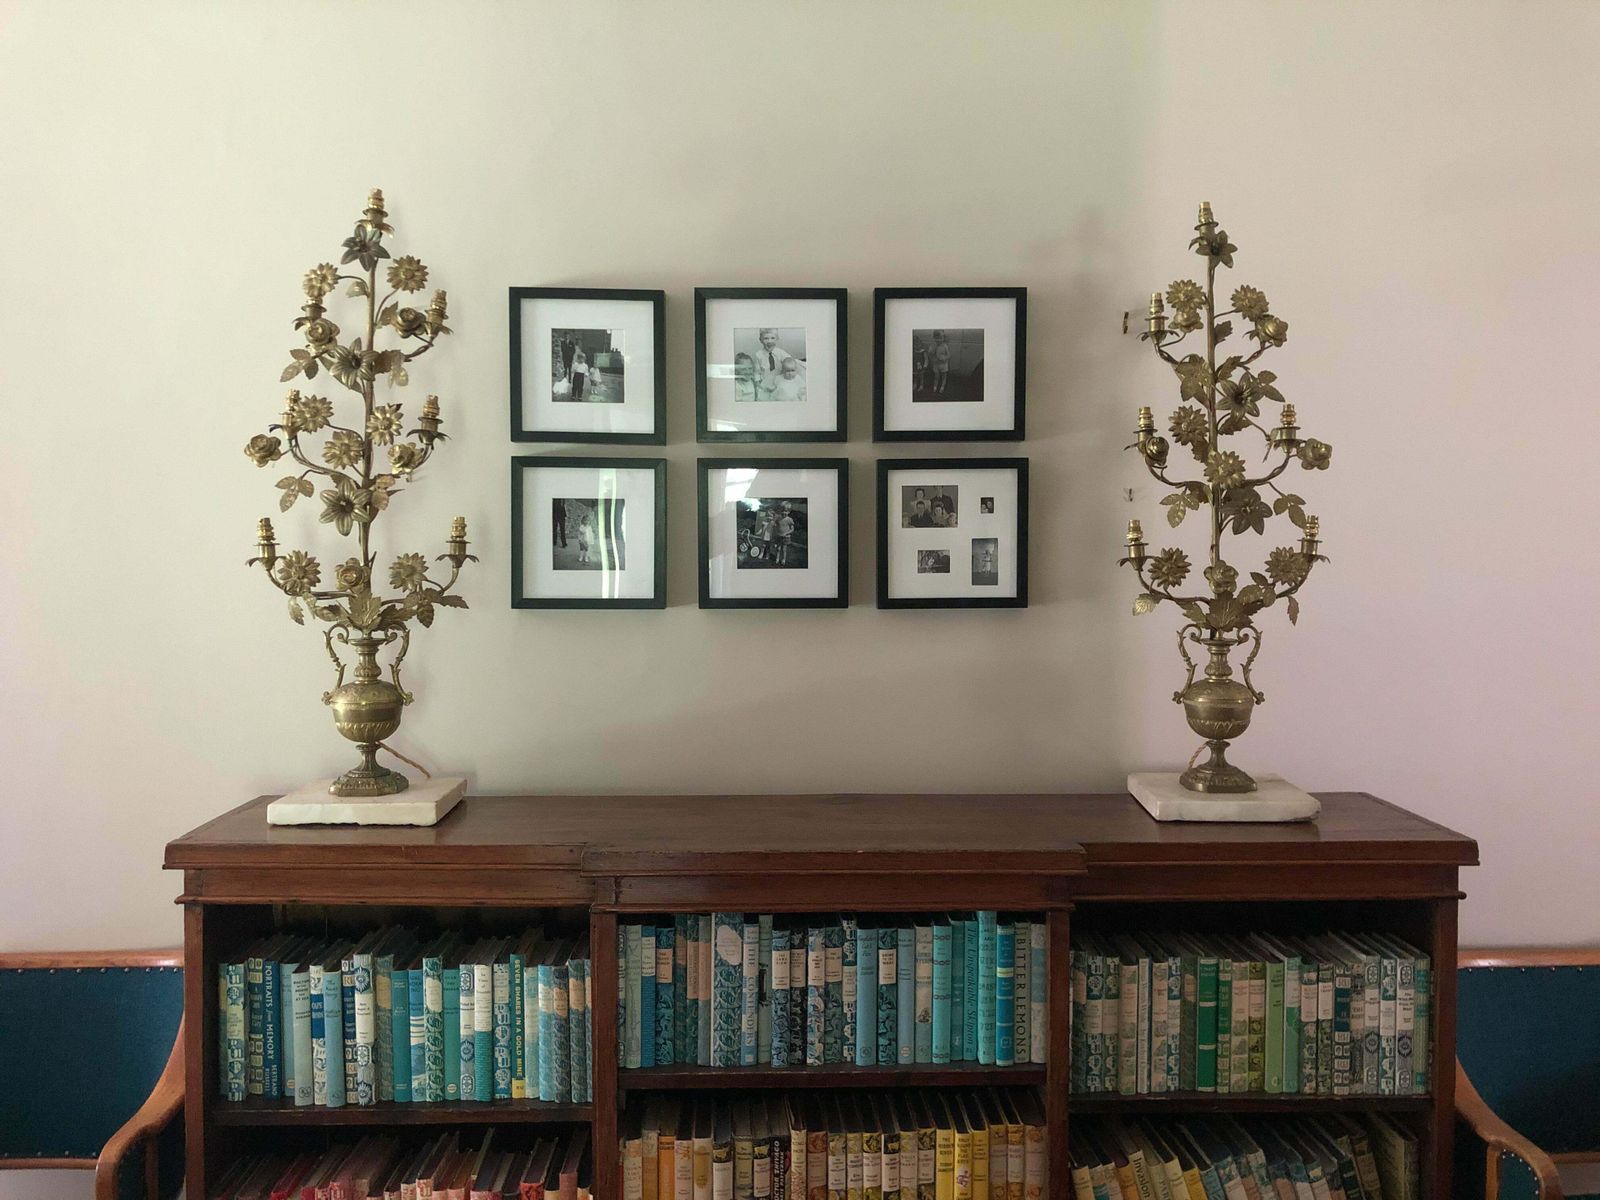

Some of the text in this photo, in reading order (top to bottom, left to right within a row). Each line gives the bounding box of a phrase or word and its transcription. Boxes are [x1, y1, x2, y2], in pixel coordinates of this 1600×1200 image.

[514, 959, 522, 984] SEVEN
[747, 948, 756, 969] THE
[265, 965, 274, 1007] PORTRAITS
[514, 986, 522, 1015] SHARES
[964, 927, 977, 1045] The Unspeakable Skipton
[1015, 938, 1027, 1055] BITTER LEMONS
[515, 1017, 522, 1026] IN
[745, 976, 756, 1046] CONTENDERS
[265, 1023, 275, 1060] MEMORY
[1133, 1156, 1151, 1199] Invasion
